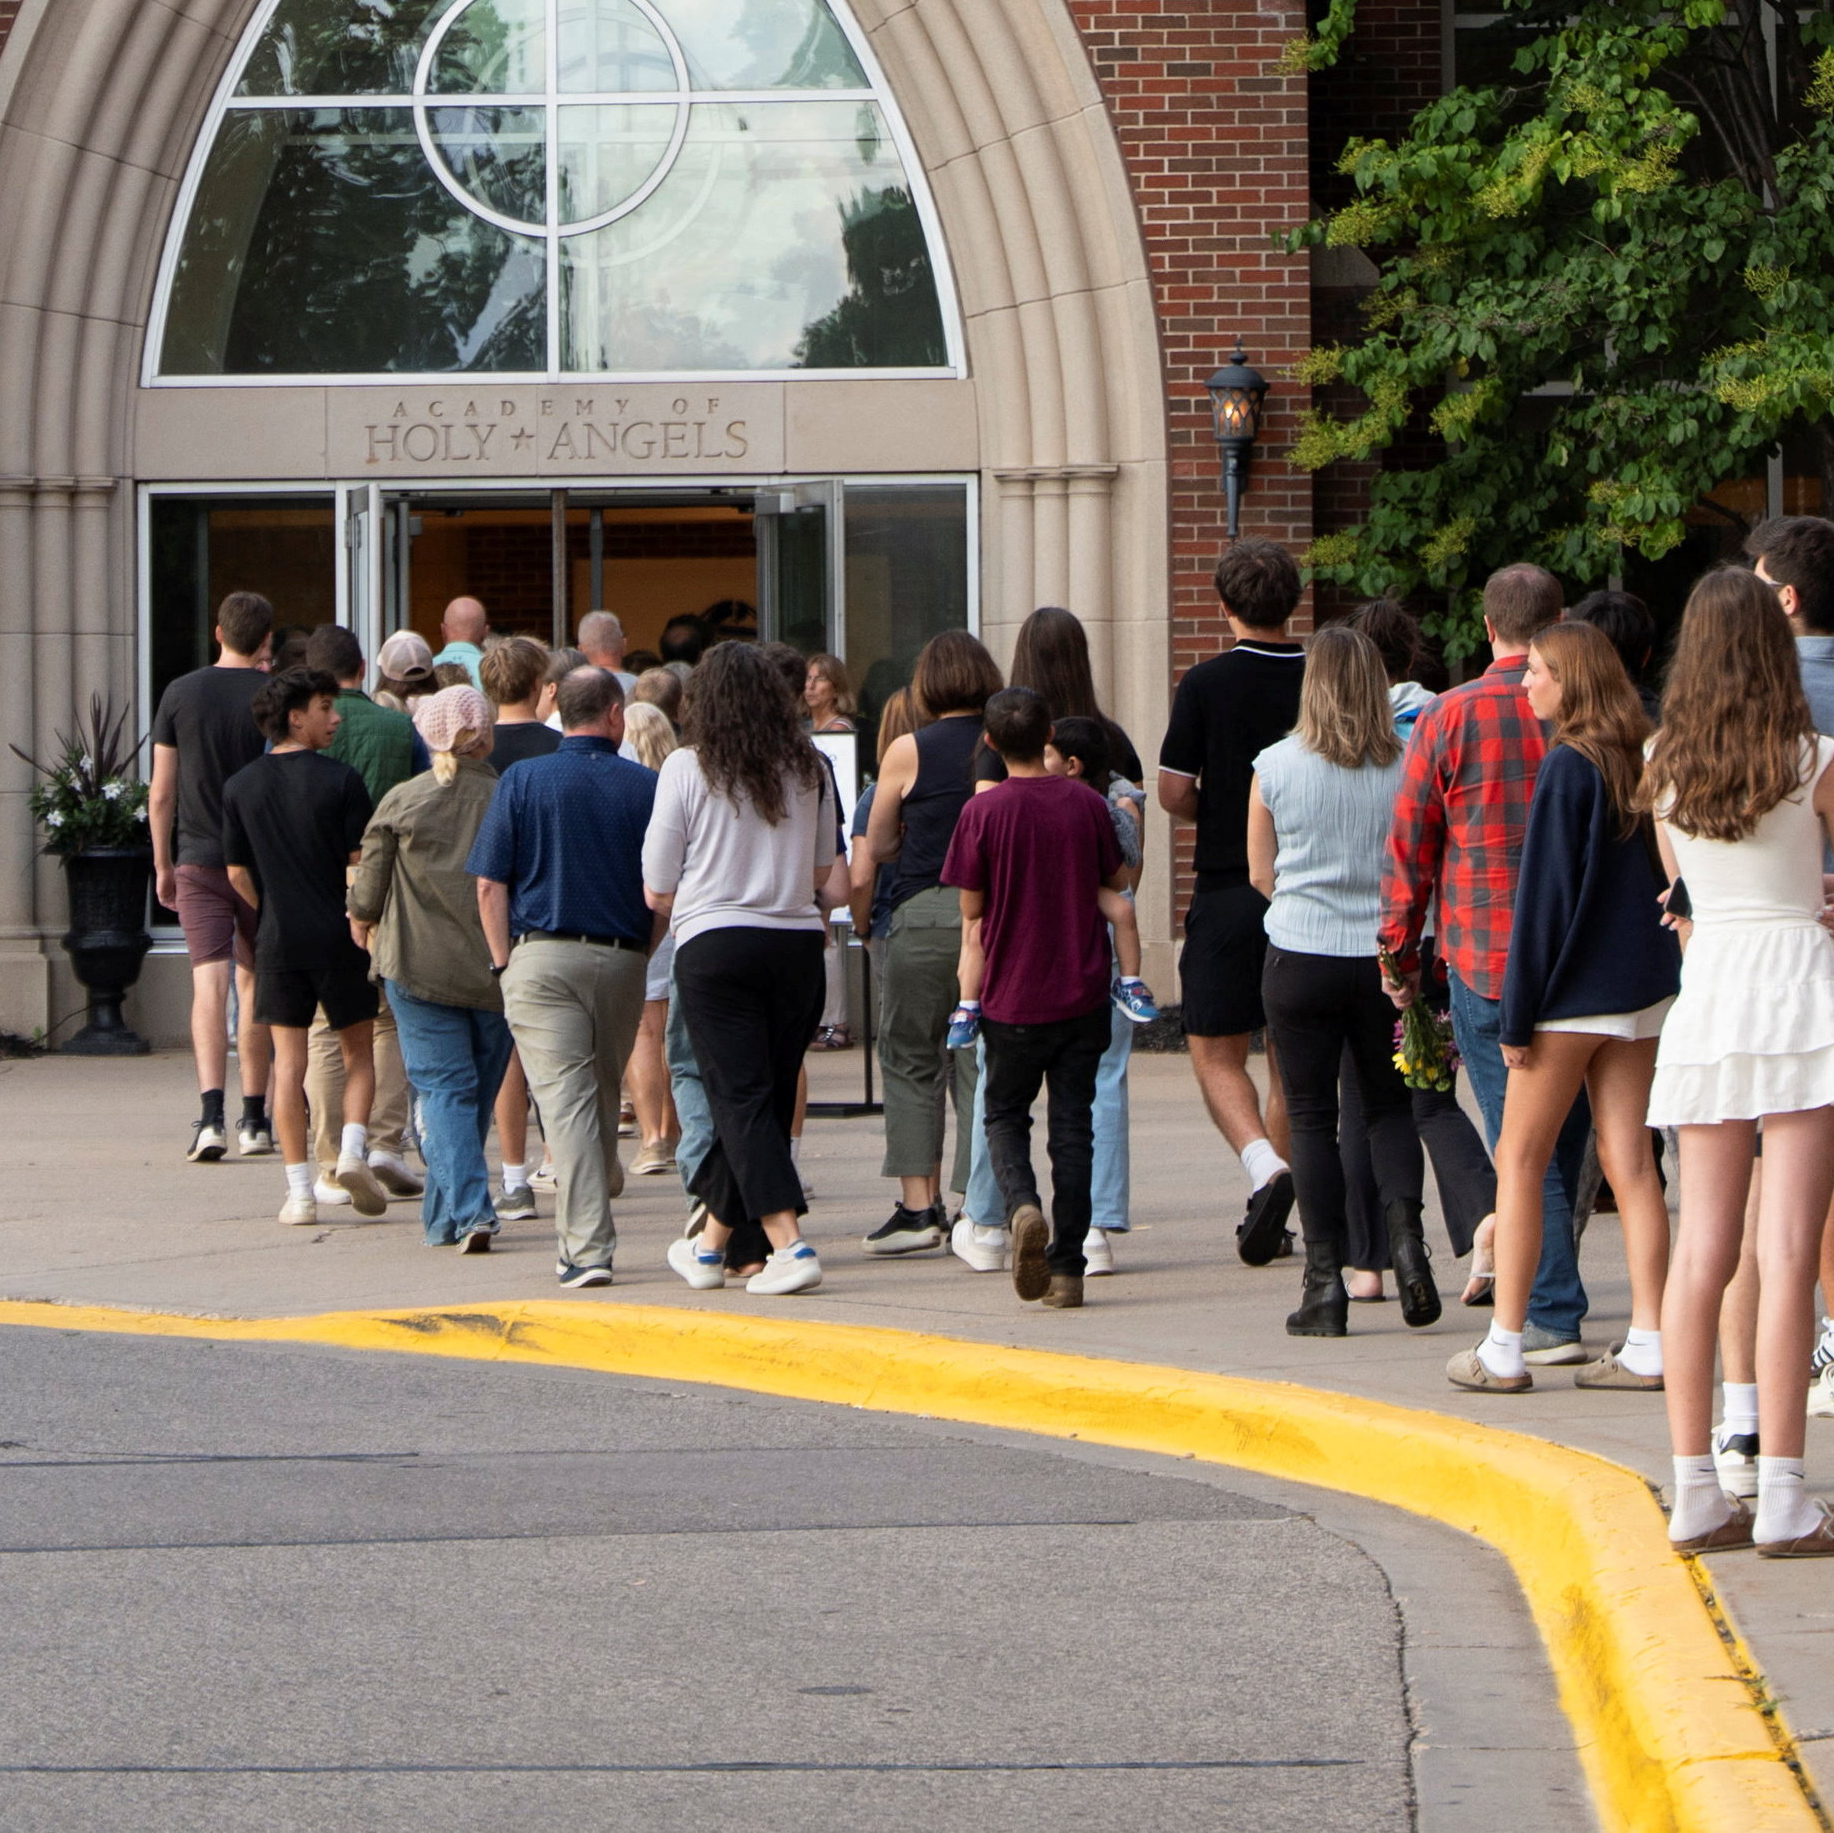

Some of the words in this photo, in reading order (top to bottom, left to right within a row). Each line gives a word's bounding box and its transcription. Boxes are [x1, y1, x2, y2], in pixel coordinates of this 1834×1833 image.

[392, 398, 630, 418] ACADEMY
[672, 397, 720, 416] OF
[365, 423, 497, 464] HOLY
[546, 420, 749, 461] ANGELS
